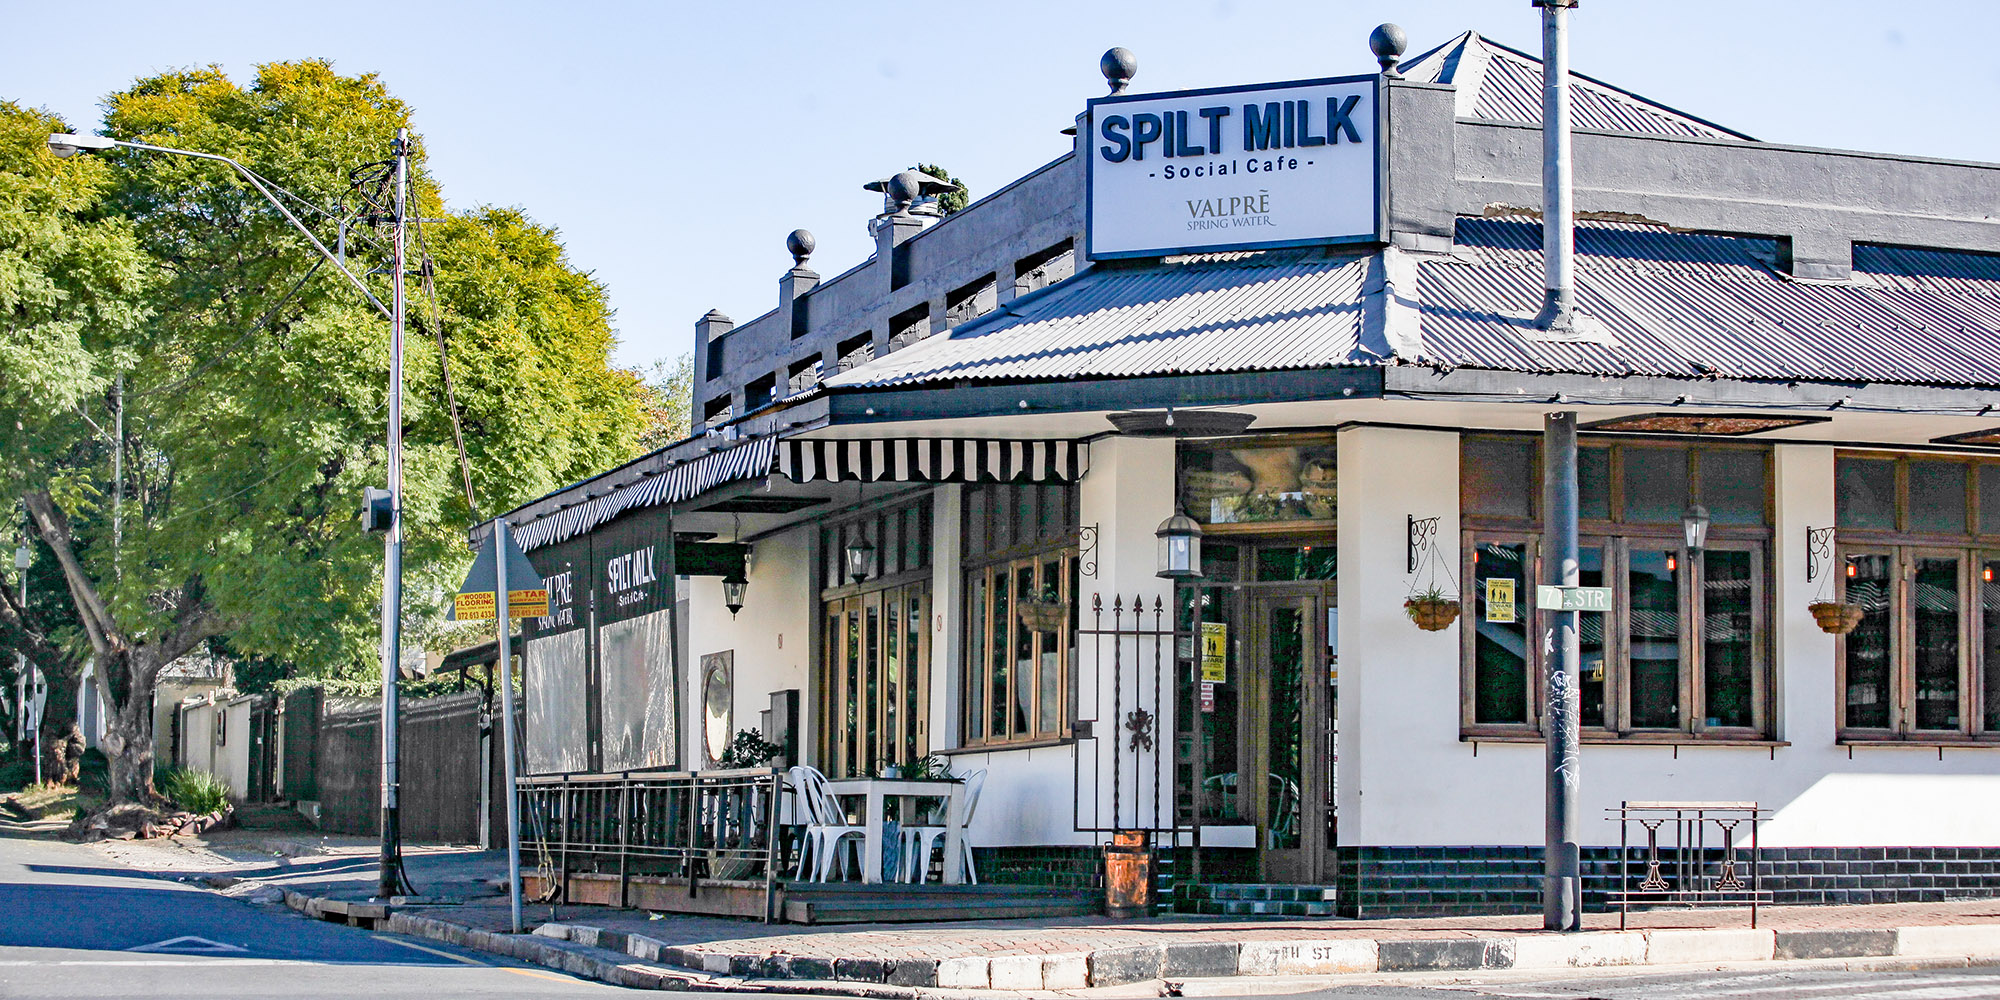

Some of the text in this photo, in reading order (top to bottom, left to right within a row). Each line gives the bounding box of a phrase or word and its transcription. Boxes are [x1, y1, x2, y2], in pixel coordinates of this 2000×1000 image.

[1100, 95, 1362, 163] SPILT MILK
[1164, 159, 1237, 180] Social
[1246, 155, 1298, 173] Cafe
[1187, 215, 1277, 231] SPRING WATER
[608, 545, 656, 594] SPILT MLK
[523, 590, 546, 598] TAR
[1544, 588, 1553, 606] 7
[1575, 589, 1604, 608] STR
[456, 599, 494, 607] FLOORING
[457, 610, 495, 620] 072 613 4334
[1312, 946, 1332, 960] ST
